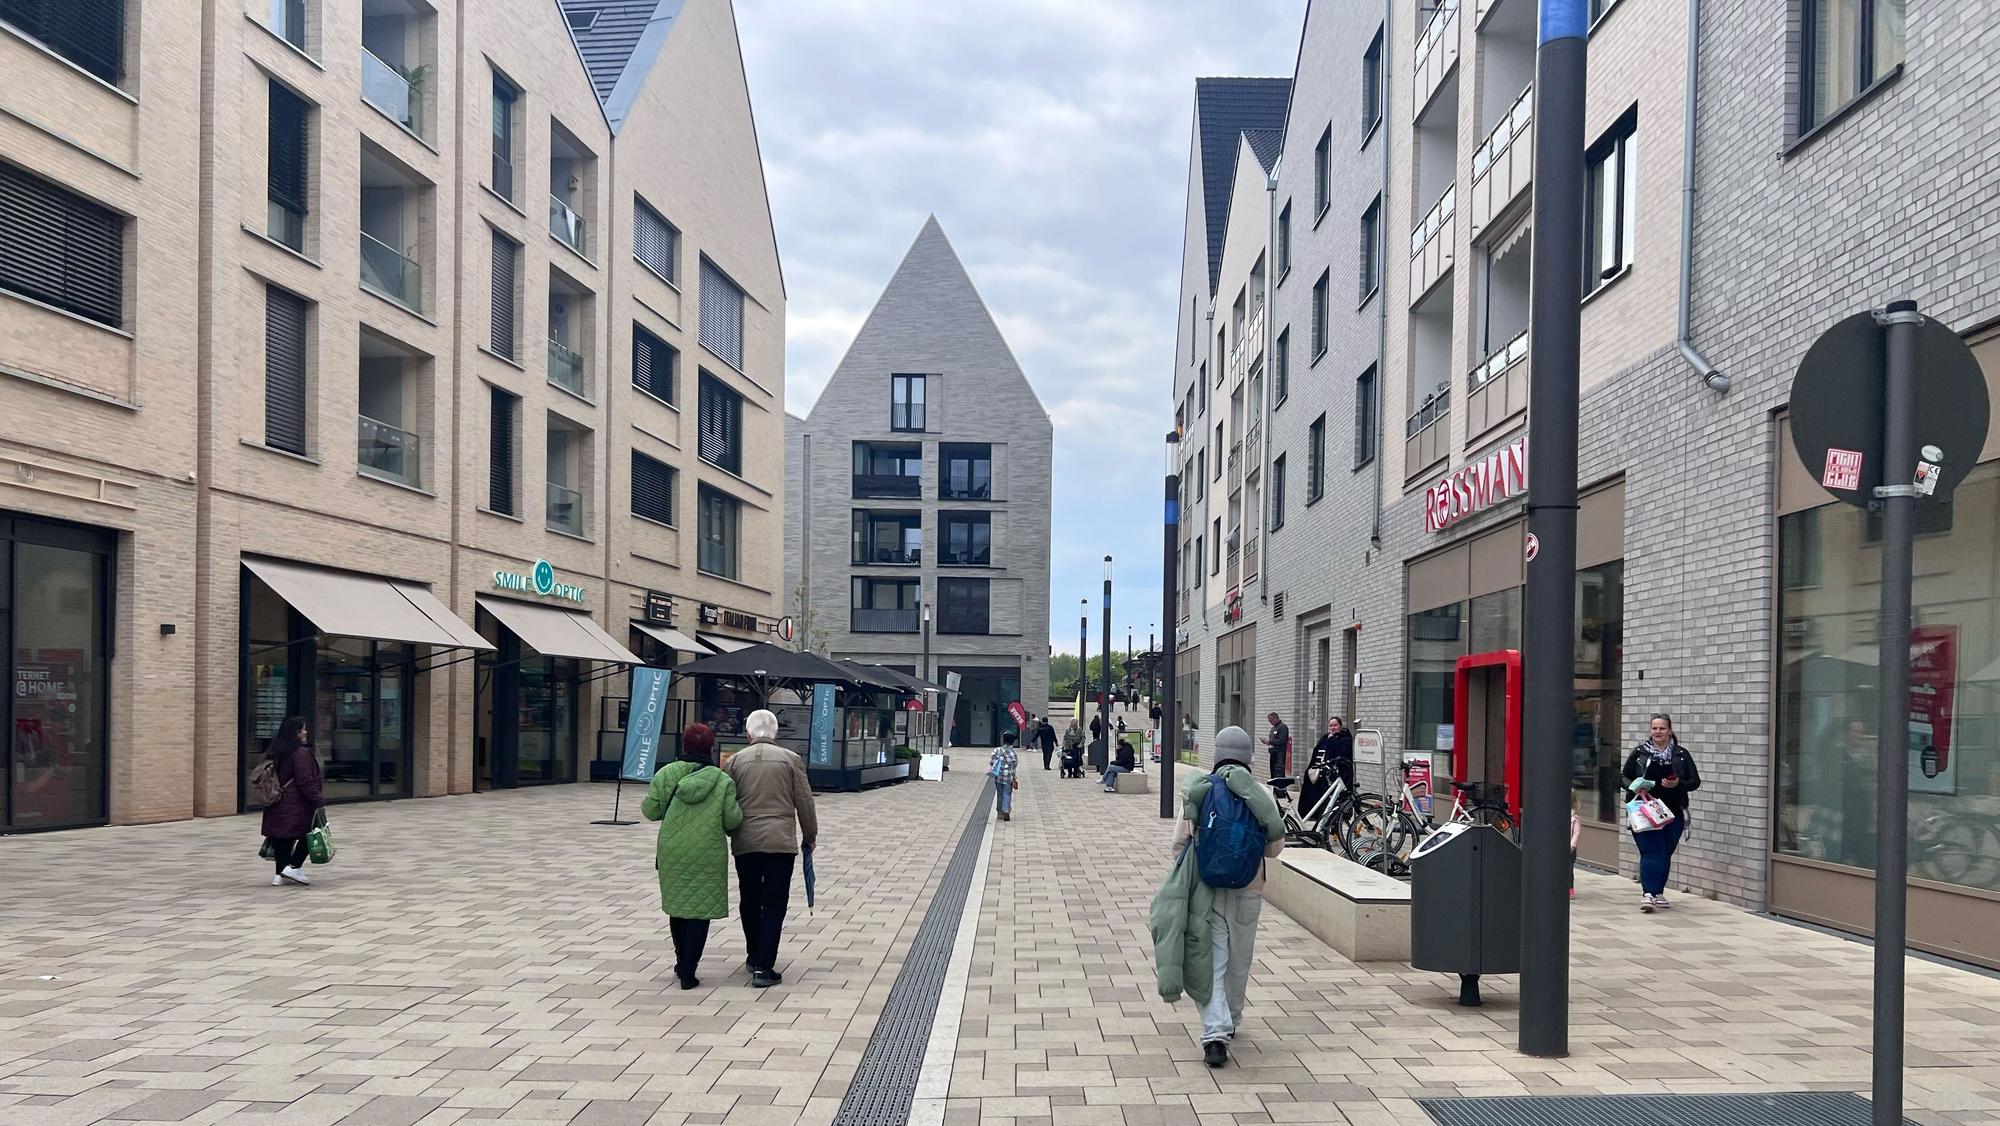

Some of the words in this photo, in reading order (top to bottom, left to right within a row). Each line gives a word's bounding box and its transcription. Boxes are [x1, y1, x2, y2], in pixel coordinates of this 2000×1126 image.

[1425, 437, 1529, 533] ROSSMAN
[493, 570, 533, 593] SMILE
[552, 582, 587, 604] OPTIC
[637, 736, 652, 777] SMILE
[647, 671, 663, 713] OPTIC
[820, 734, 829, 763] SMILE
